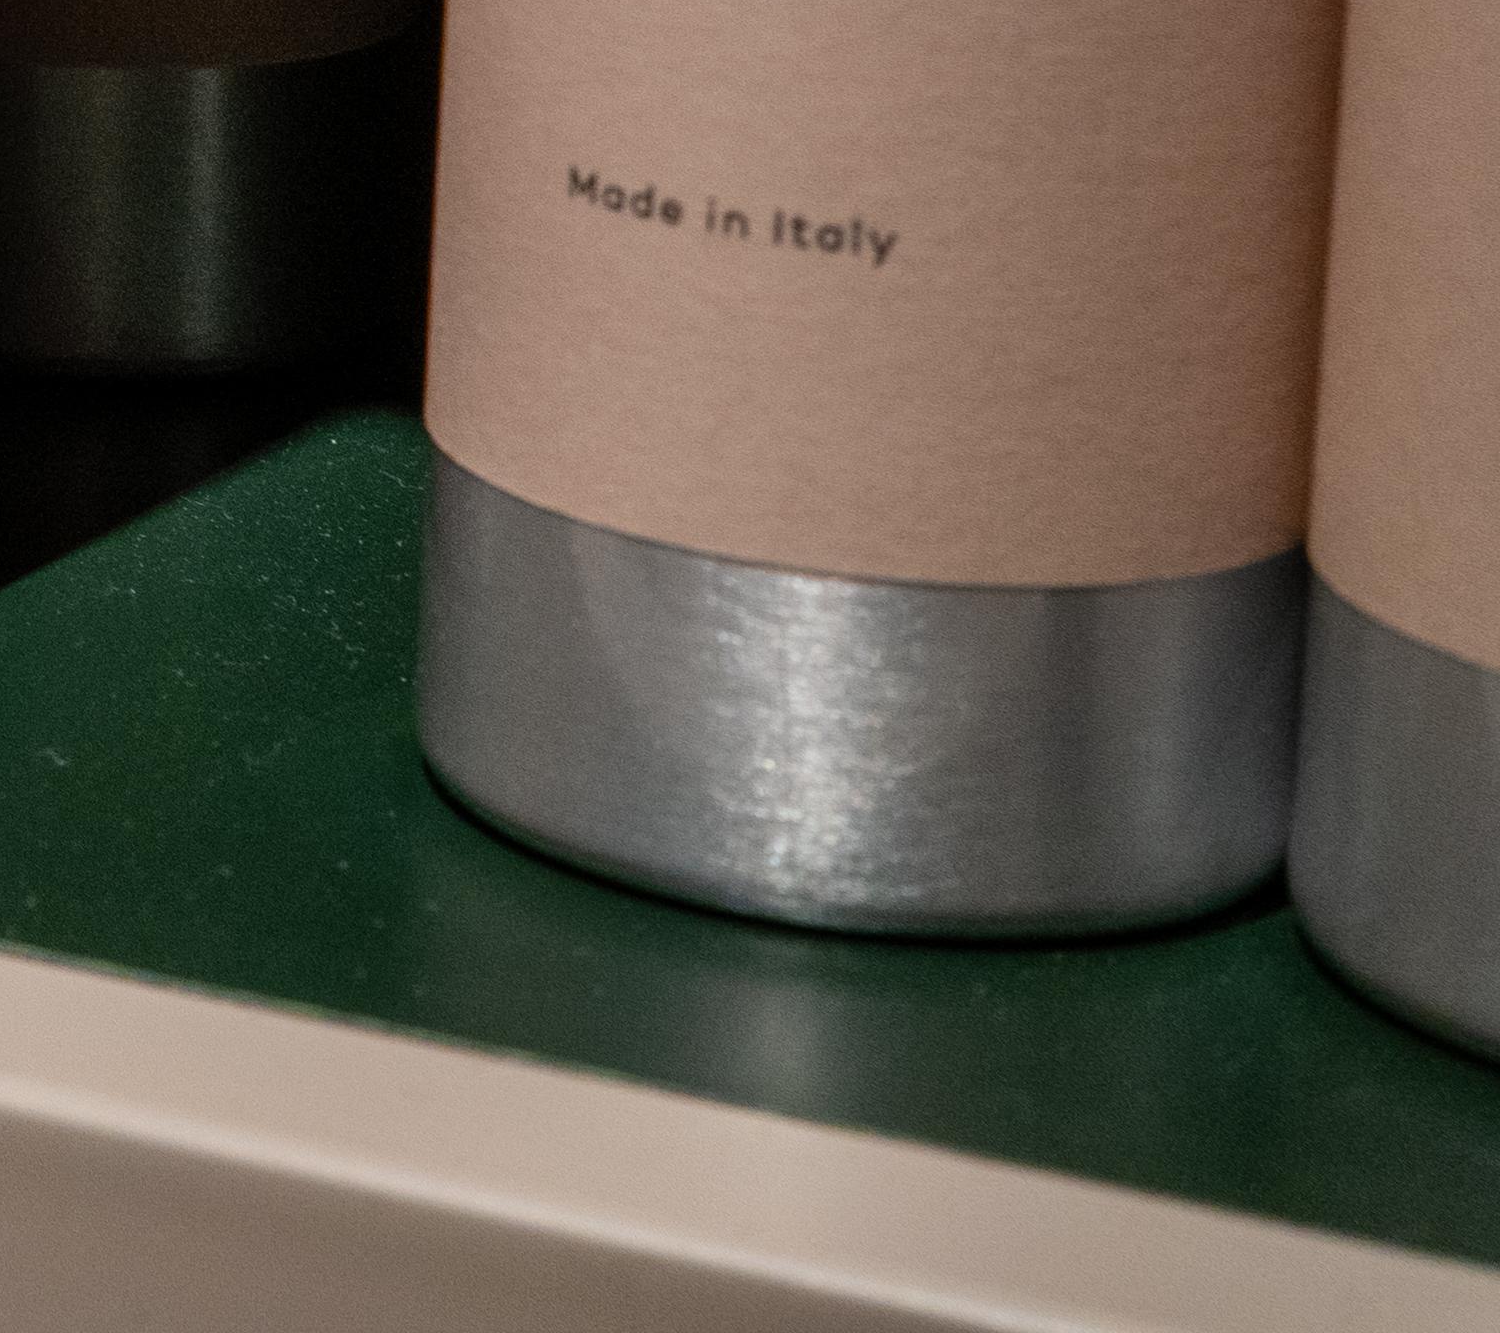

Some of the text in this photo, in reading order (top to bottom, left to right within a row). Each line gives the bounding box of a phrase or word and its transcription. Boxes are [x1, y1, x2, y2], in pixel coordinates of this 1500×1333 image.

[565, 163, 900, 271] Made in Italy
